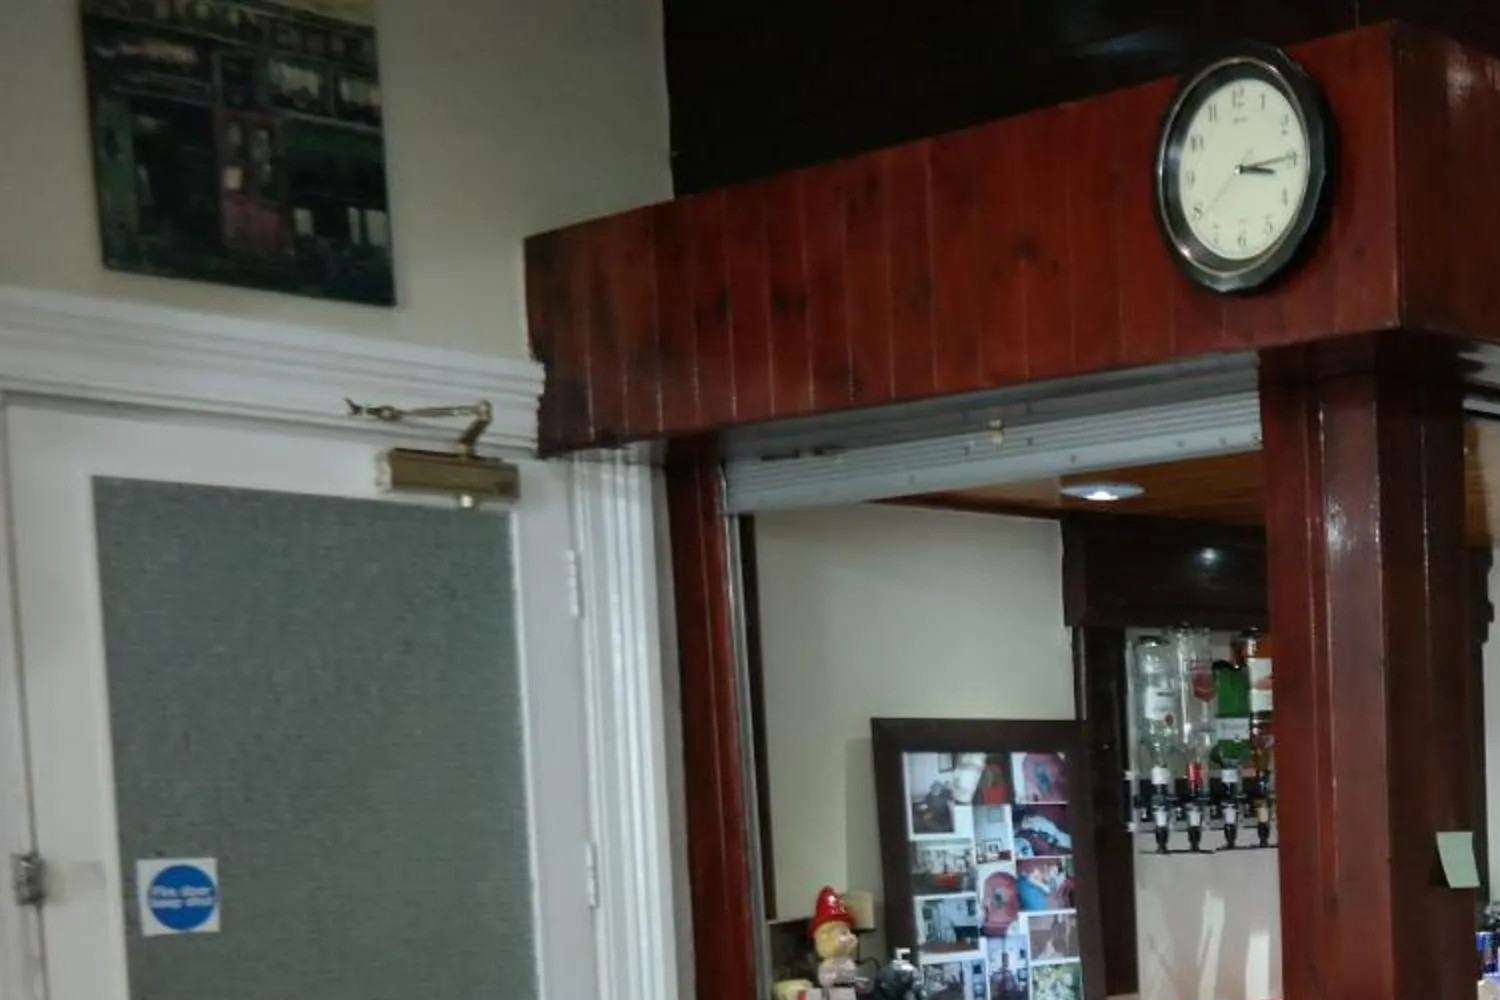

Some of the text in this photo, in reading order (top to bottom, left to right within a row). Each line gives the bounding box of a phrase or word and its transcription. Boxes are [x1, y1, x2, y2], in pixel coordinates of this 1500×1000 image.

[1232, 83, 1245, 110] 12
[1208, 103, 1218, 123] 11
[1278, 114, 1289, 136] 2
